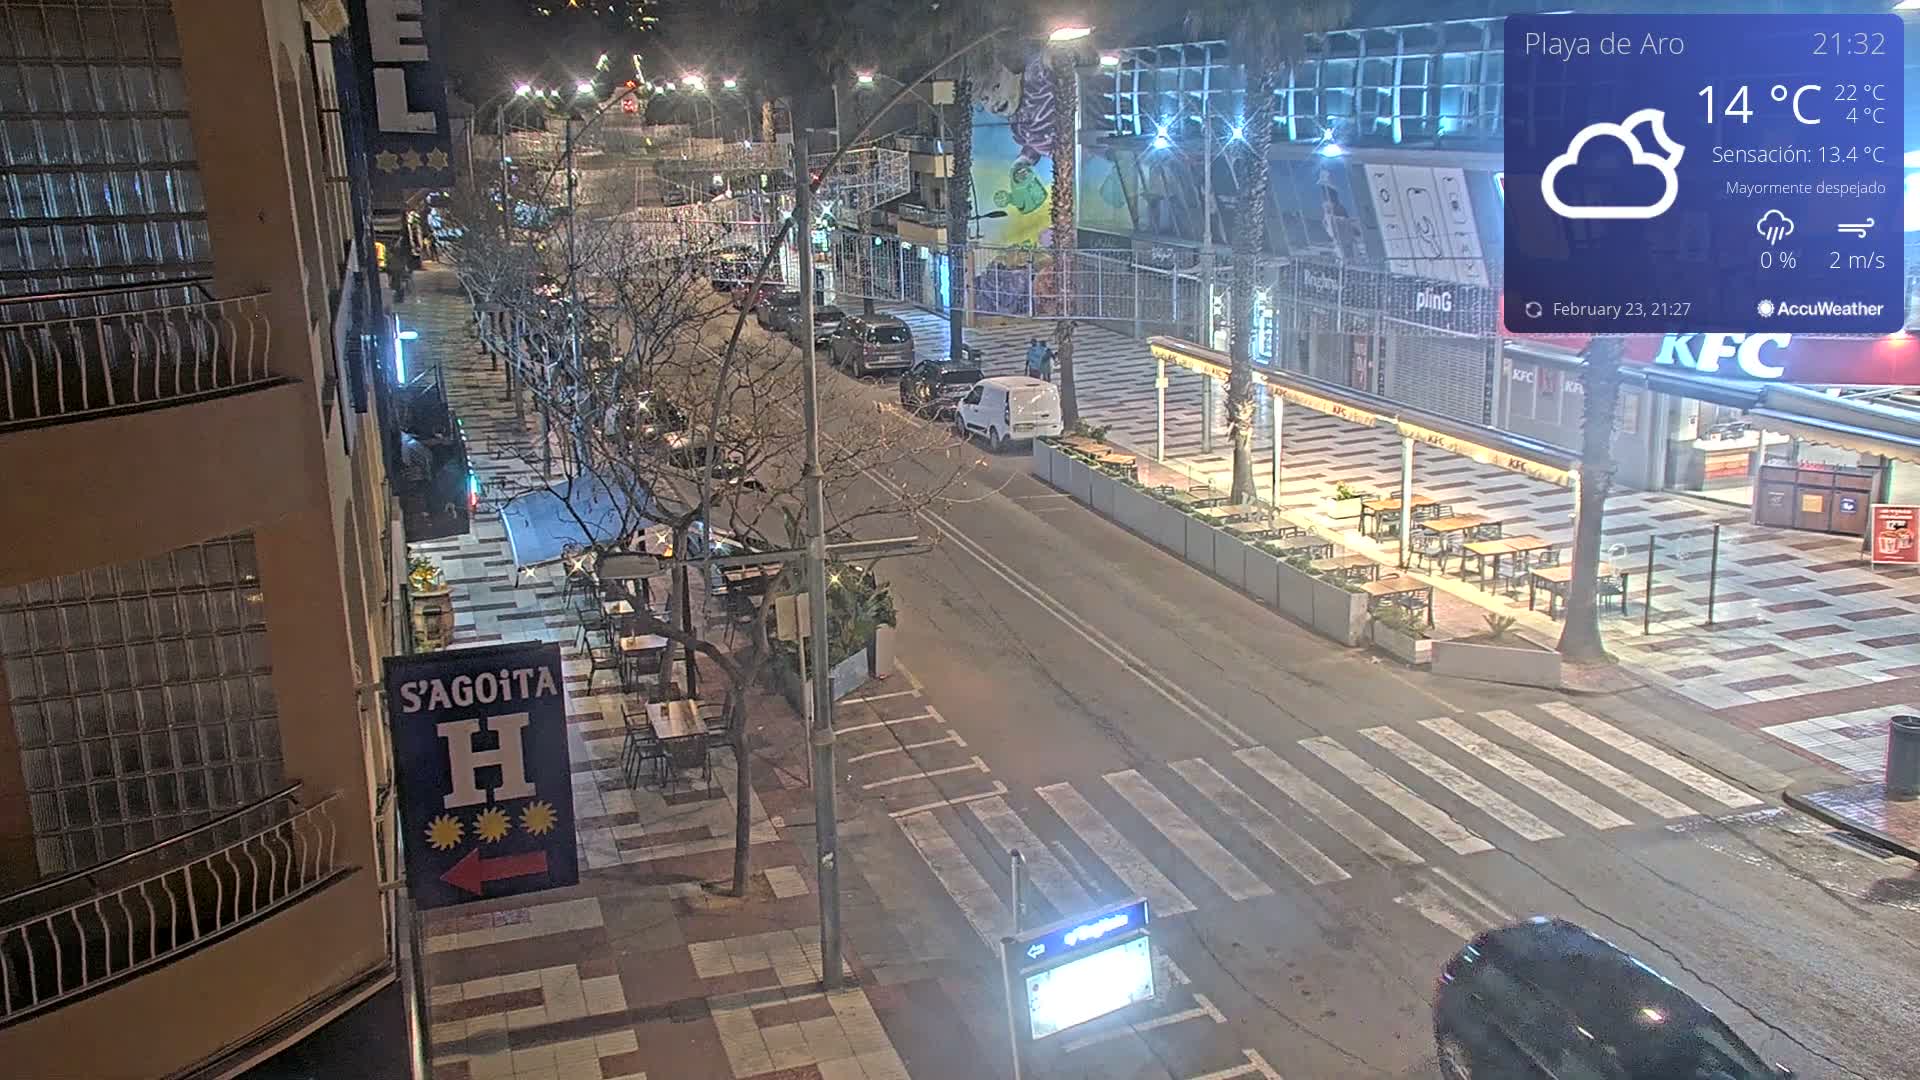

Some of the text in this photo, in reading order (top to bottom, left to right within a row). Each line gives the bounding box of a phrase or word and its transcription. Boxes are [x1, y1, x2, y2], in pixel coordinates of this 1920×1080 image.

[1655, 333, 1793, 378] KFC
[1512, 368, 1535, 384] KFC
[1427, 433, 1446, 447] KFC
[1508, 457, 1528, 473] KFC
[436, 712, 538, 810] H
